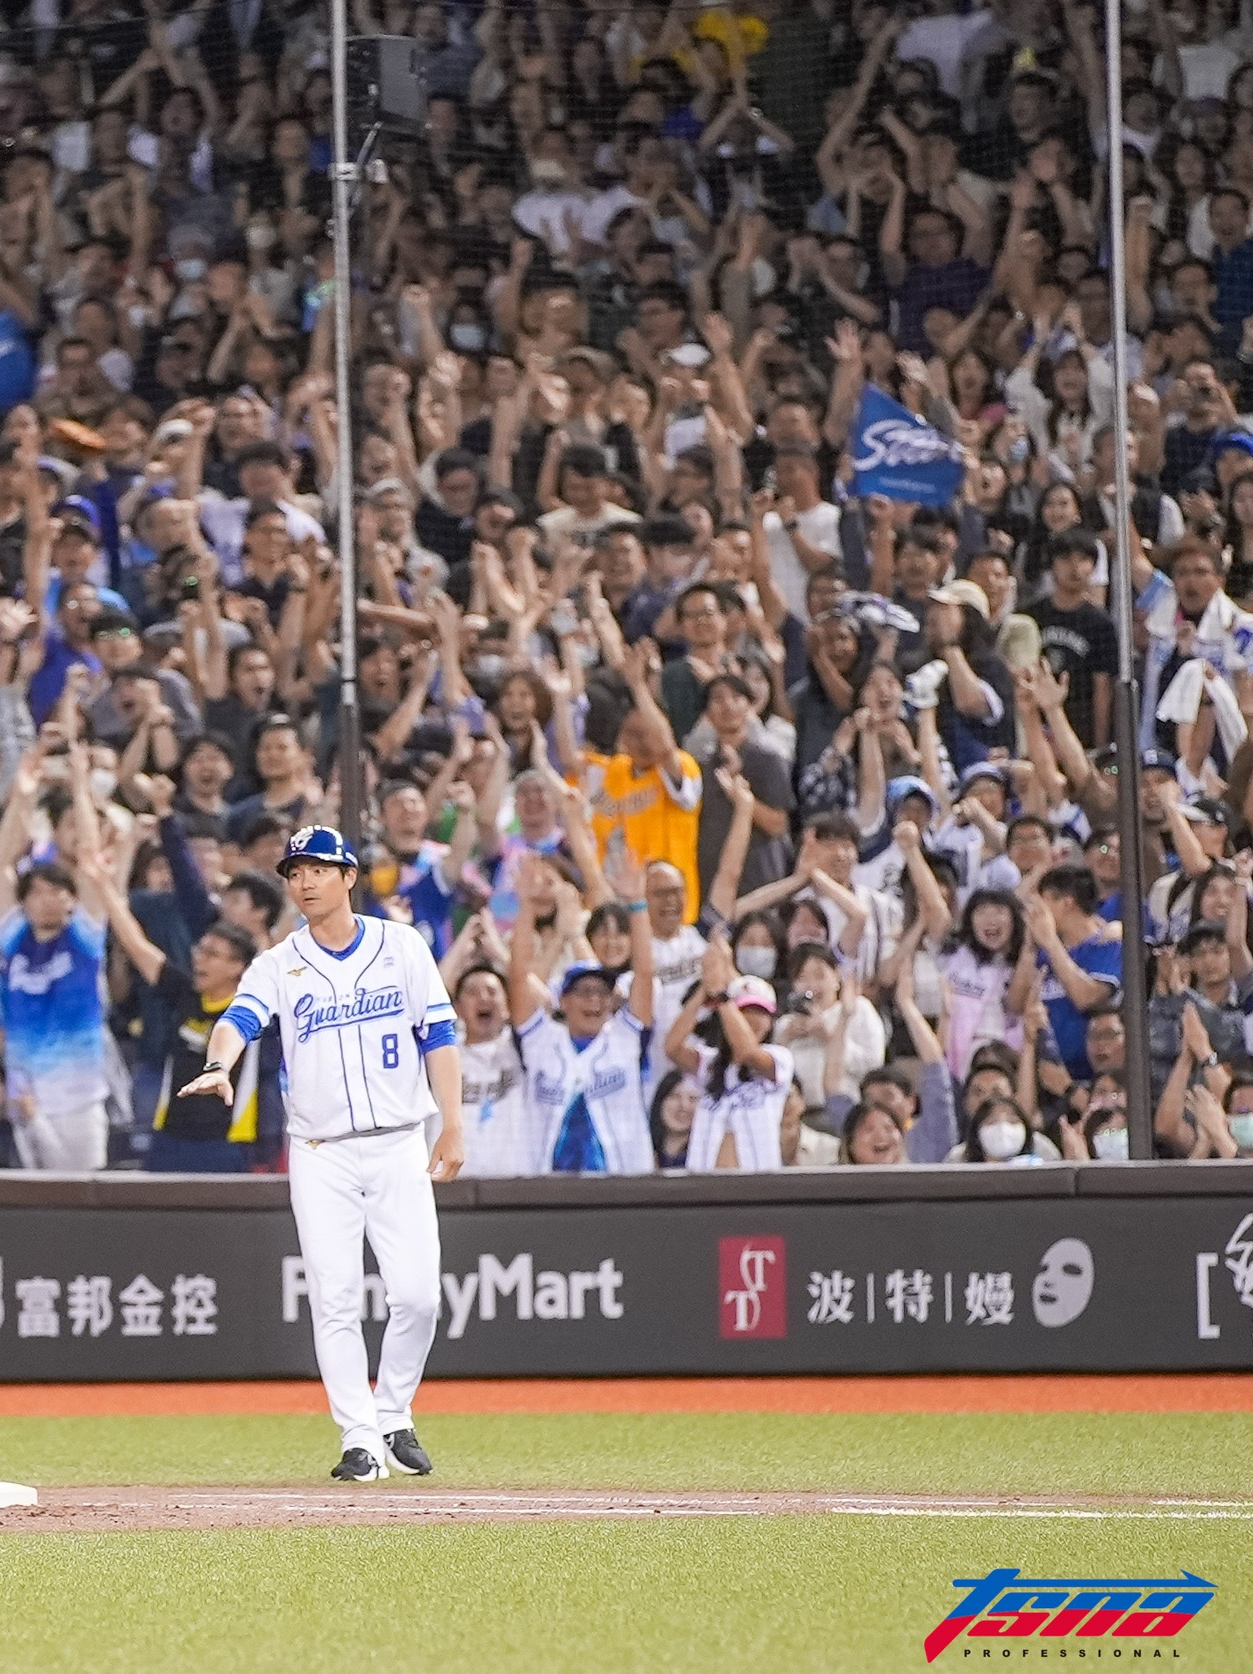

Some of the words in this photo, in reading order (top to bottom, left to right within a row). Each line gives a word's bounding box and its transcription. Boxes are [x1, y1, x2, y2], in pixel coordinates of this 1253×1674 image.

[294, 987, 404, 1043] Guardian
[381, 1033, 399, 1069] 8
[15, 1273, 219, 1338] 富邦金控
[281, 1253, 624, 1339] FyMart
